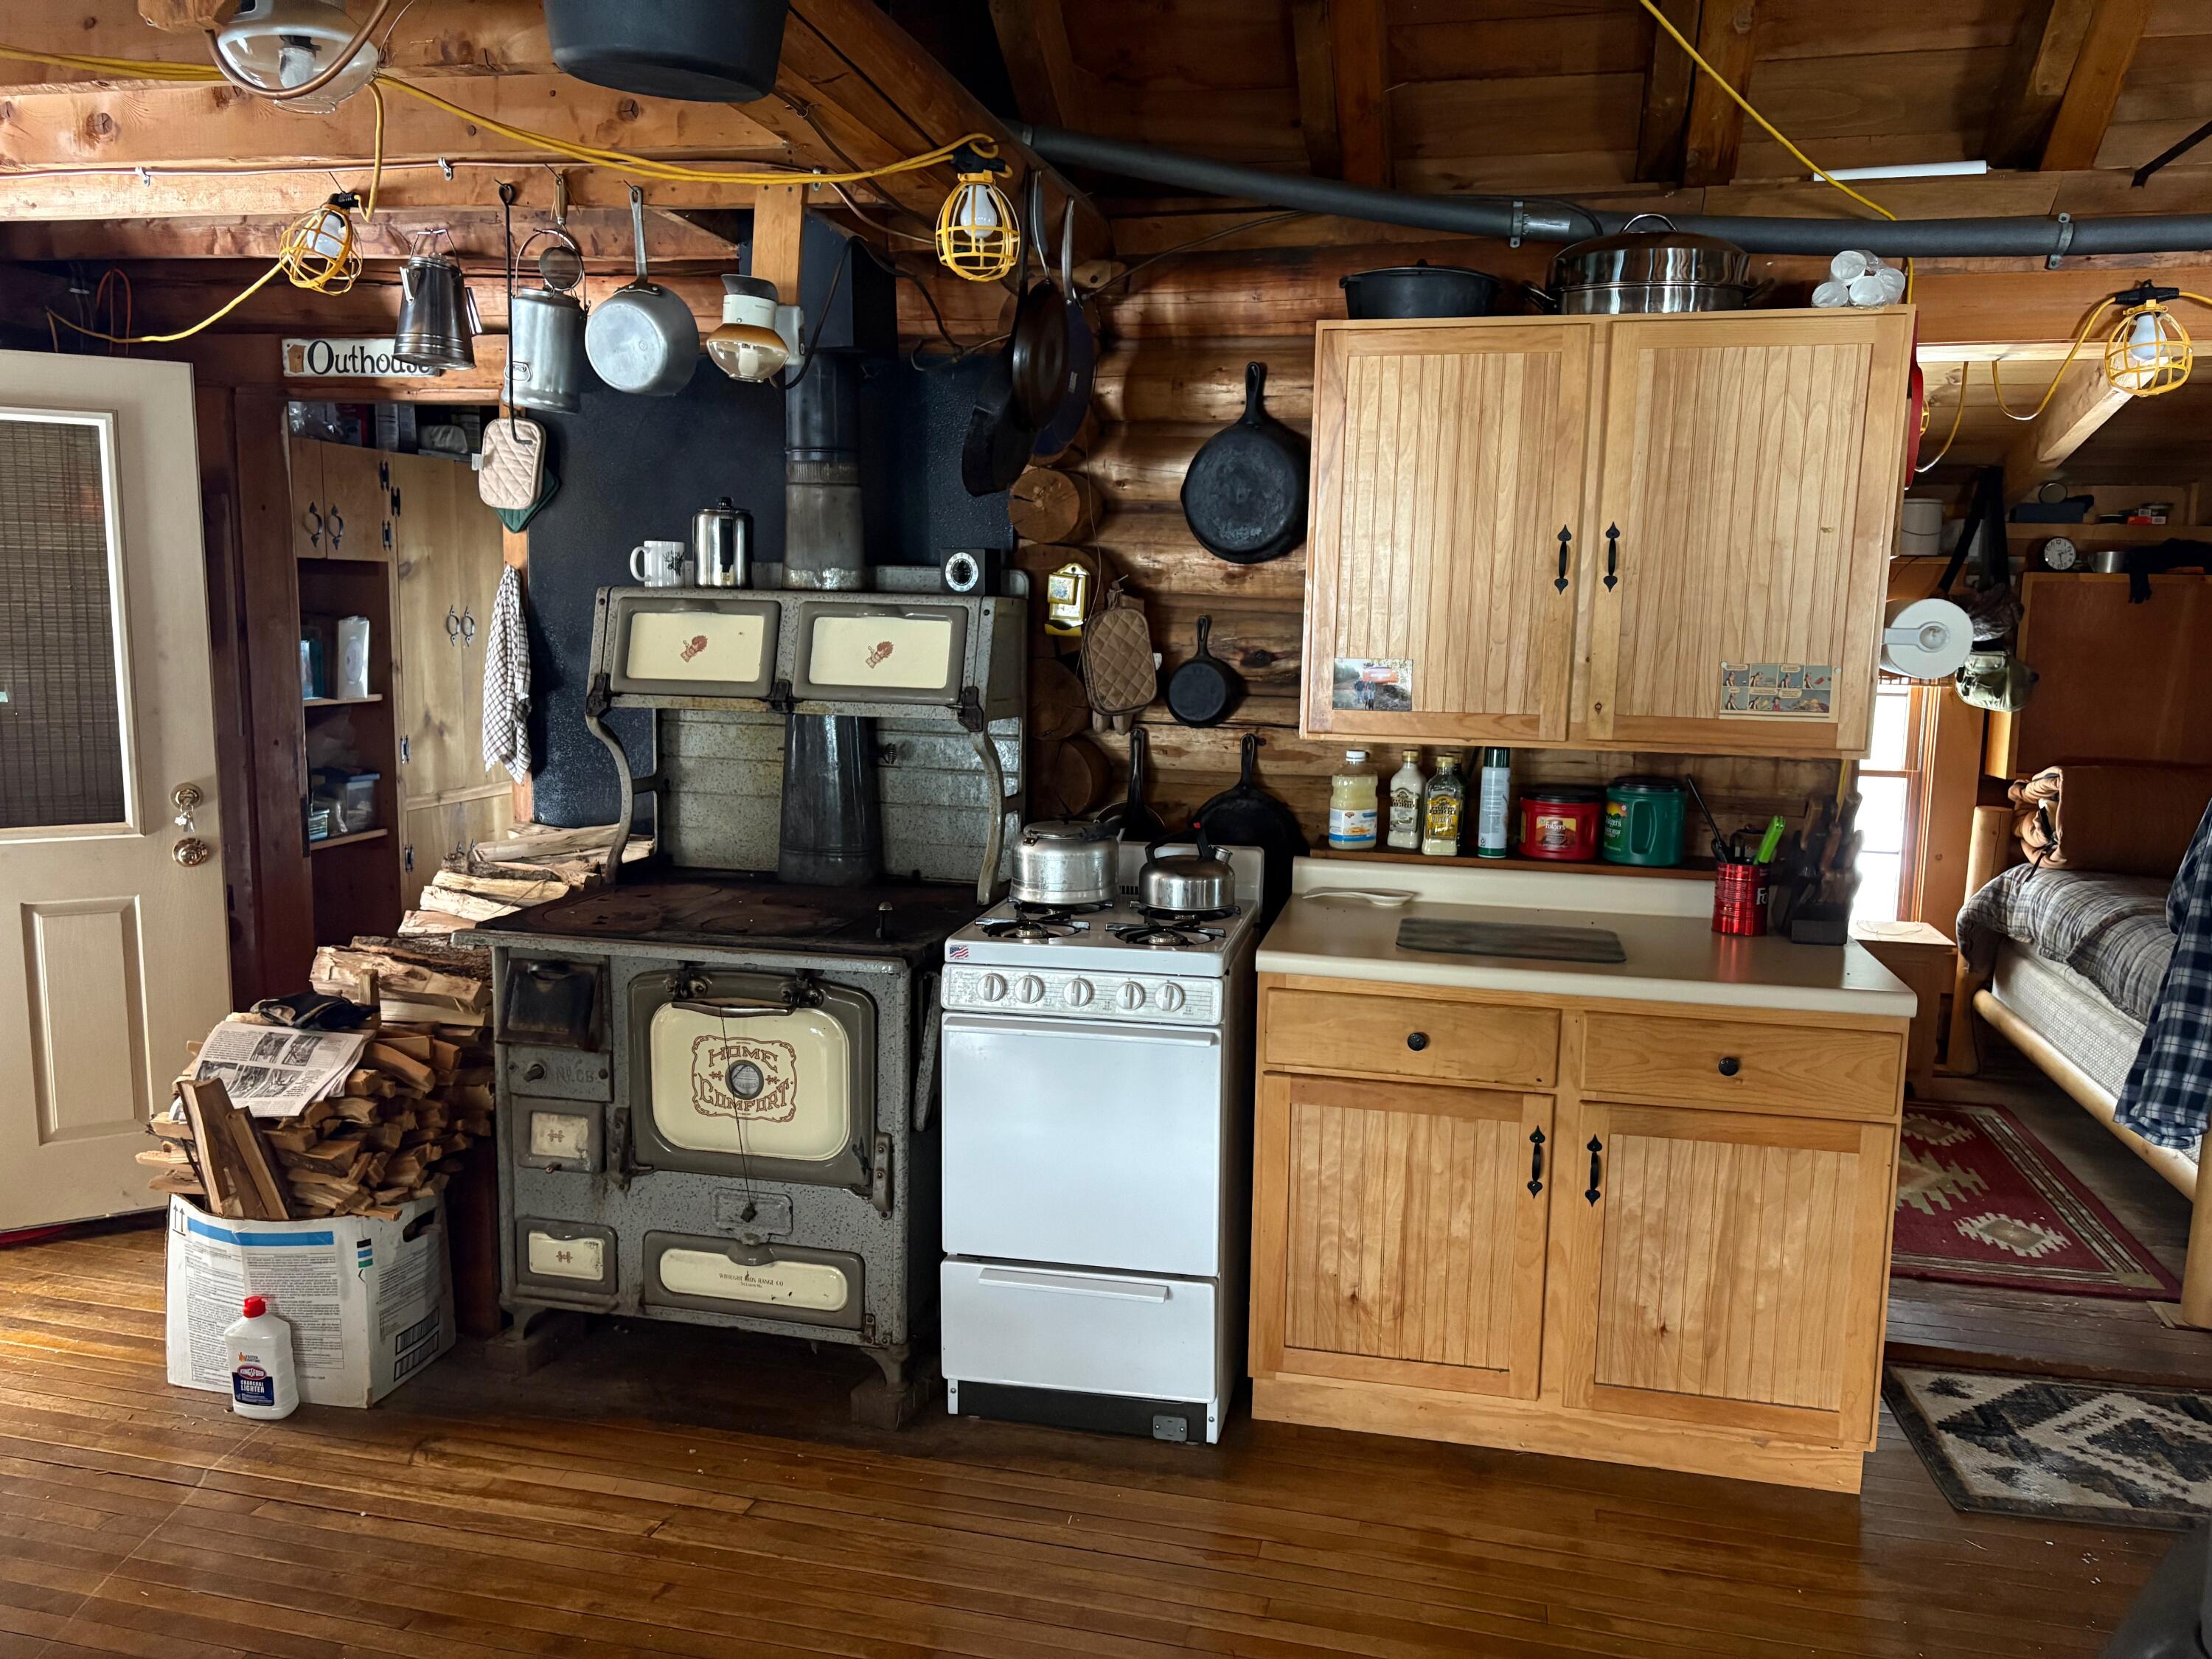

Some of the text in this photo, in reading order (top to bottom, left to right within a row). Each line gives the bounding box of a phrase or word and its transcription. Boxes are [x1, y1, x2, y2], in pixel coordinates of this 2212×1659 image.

[708, 1045, 779, 1074] HOME
[698, 1072, 790, 1112] COMFORT
[758, 1278, 773, 1286] RANGE
